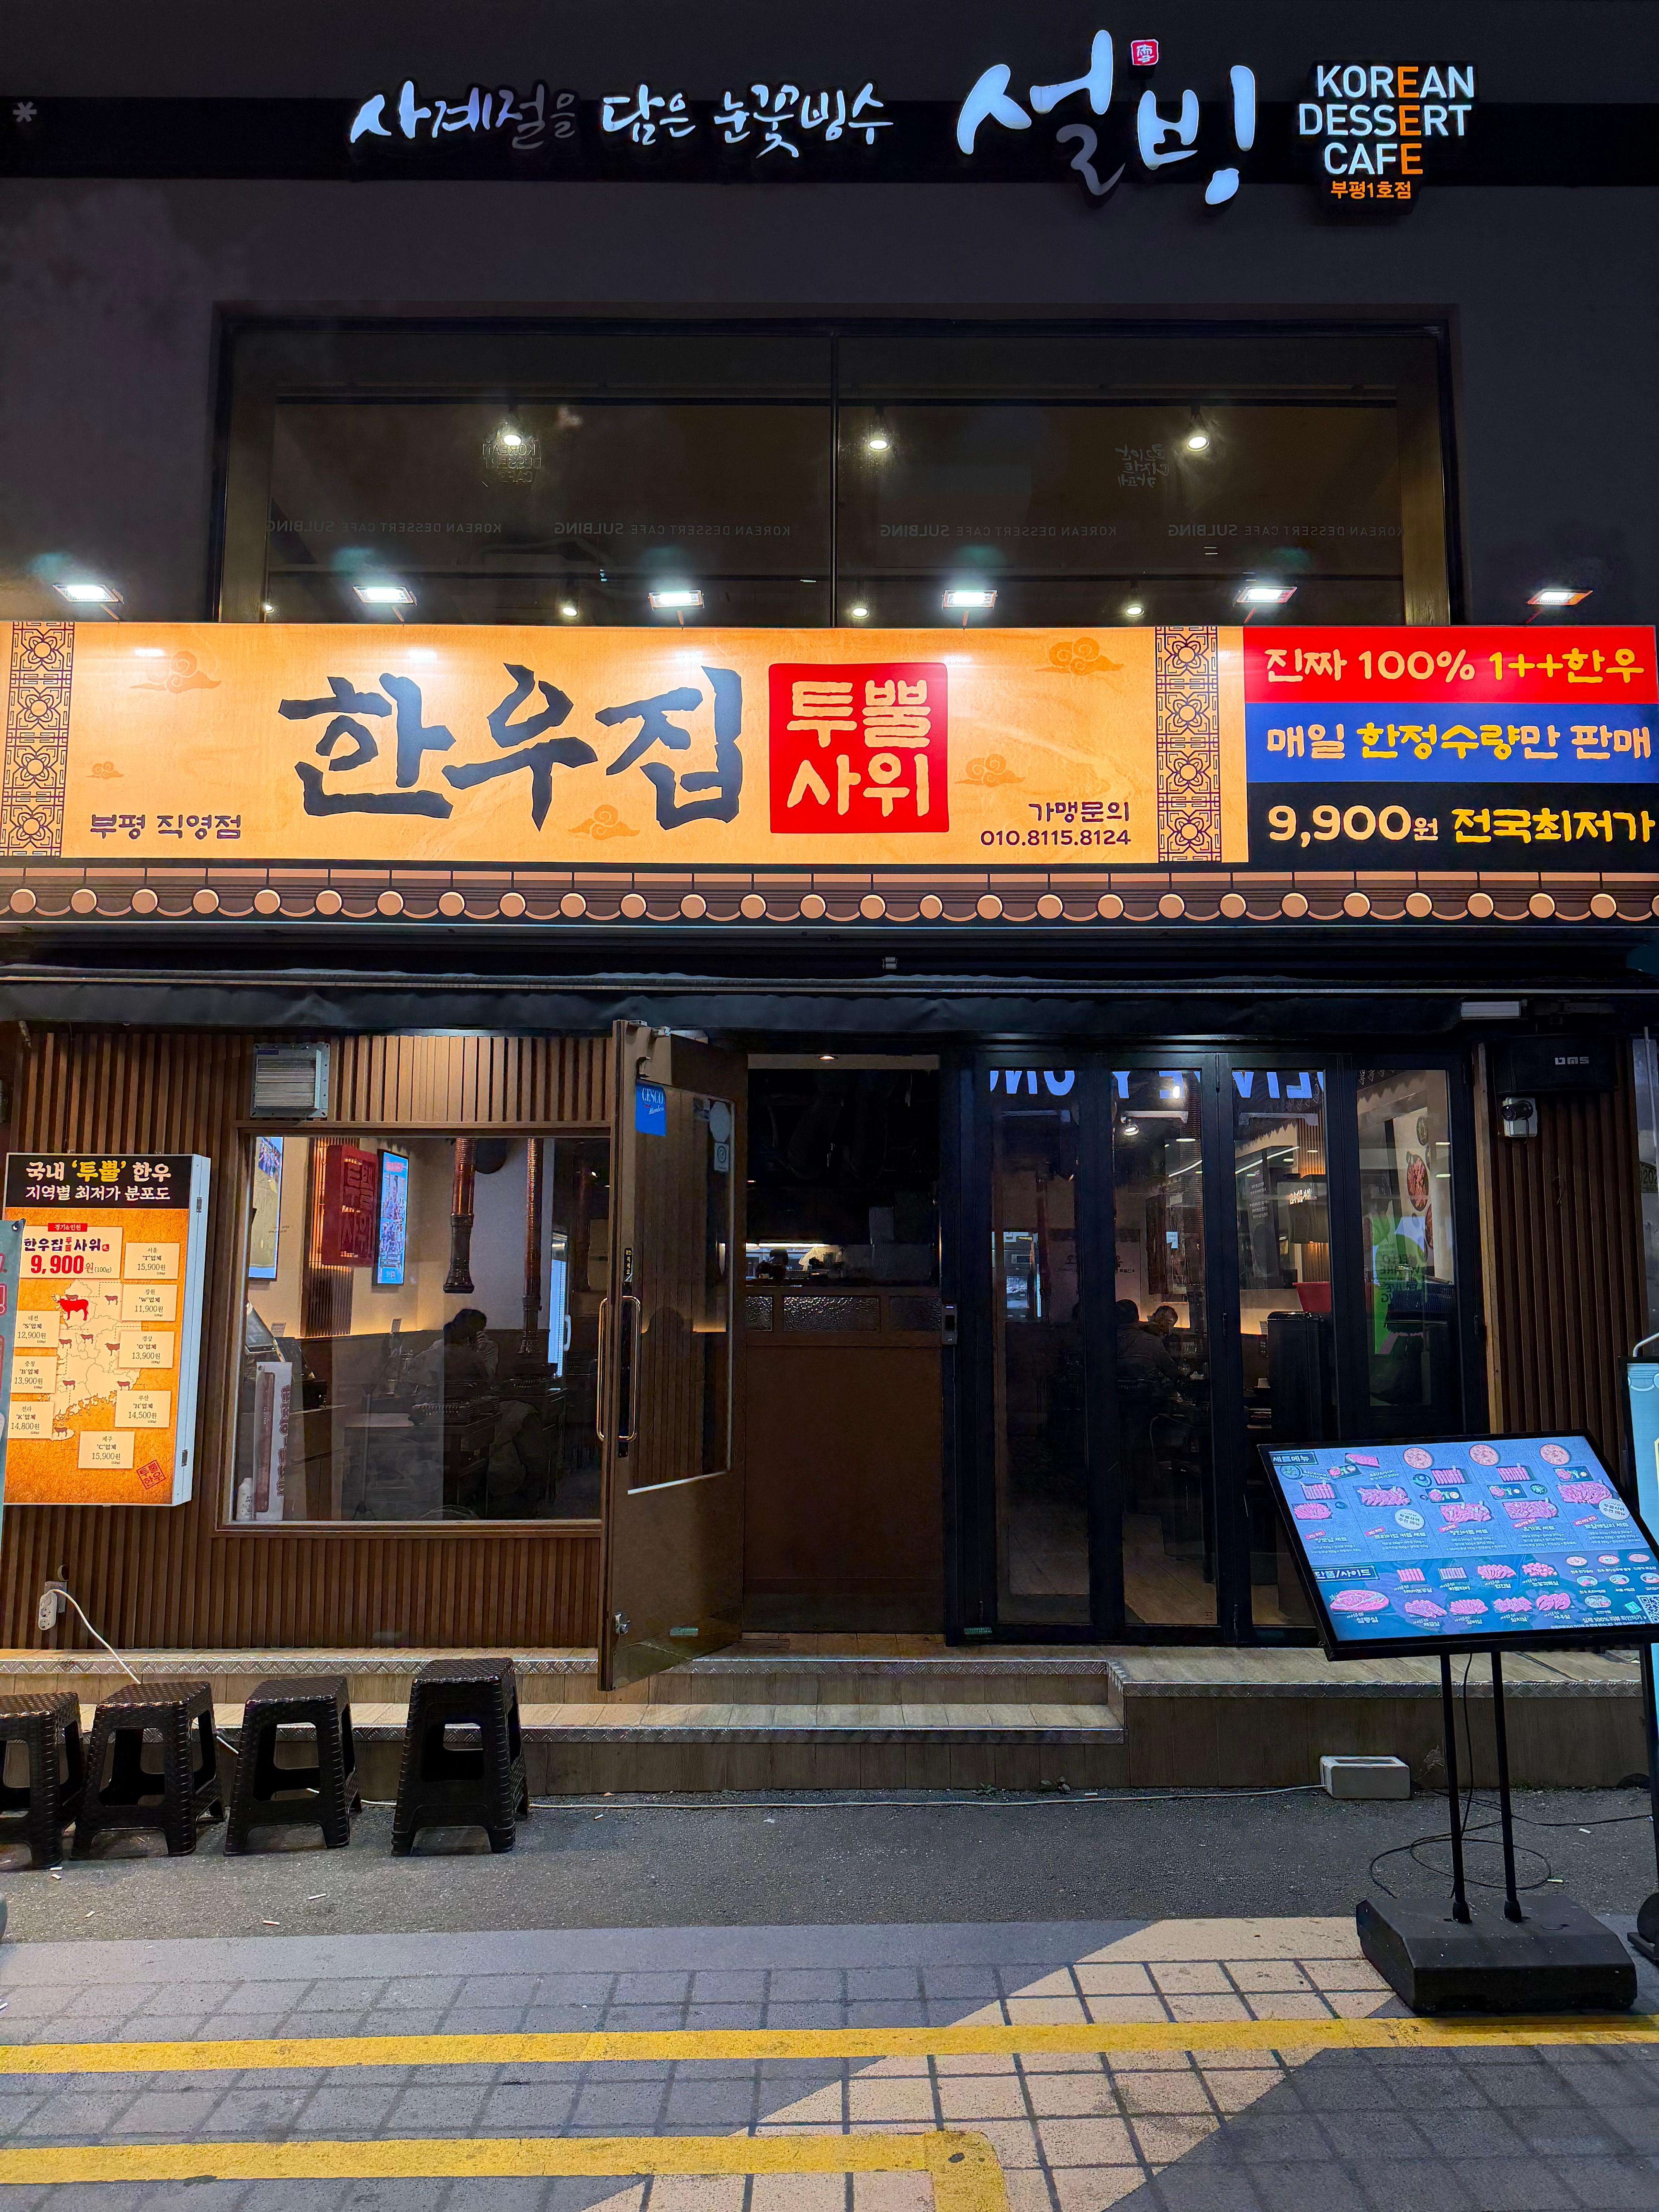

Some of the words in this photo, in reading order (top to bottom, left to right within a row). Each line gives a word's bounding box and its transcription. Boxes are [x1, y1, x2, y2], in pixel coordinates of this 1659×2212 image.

[1317, 65, 1474, 99] KOREAN
[350, 80, 580, 150] 사계절을
[602, 84, 696, 145] 담은
[714, 83, 894, 157] 눈꽃빙수
[957, 29, 1255, 205] 설빙
[1299, 103, 1472, 137] DESSERT
[1323, 142, 1424, 176] CAFE
[1330, 181, 1412, 200] 부평1호점
[1265, 649, 1347, 683] 진짜
[1358, 649, 1475, 683] 100%
[1490, 648, 1644, 684] 1++한우
[787, 678, 931, 749] 투뿔
[278, 662, 742, 831] 한우집
[1267, 724, 1346, 759] 매일
[1357, 722, 1560, 760] 한정수량만
[1570, 725, 1651, 759] 판매
[787, 752, 931, 818] 사위
[1029, 802, 1131, 824] 가맹문의
[90, 814, 146, 840] 부평
[156, 814, 242, 840] 직영점
[1267, 805, 1439, 848] 9,900원
[1451, 808, 1656, 843] 전국최저가
[980, 830, 1132, 848] 010.8115.8124
[642, 1087, 664, 1104] CESCO
[26, 1162, 65, 1182] 국내
[132, 1162, 172, 1182] 한우
[26, 1185, 70, 1200] 지역별
[75, 1186, 121, 1200] 최저가
[125, 1186, 171, 1201] 분포도
[24, 1238, 64, 1252] 한우집
[74, 1238, 101, 1252] 사위
[31, 1255, 94, 1274] 9,900원
[17, 1331, 46, 1340] 12,900원
[132, 1352, 160, 1360] 13,900원
[14, 1377, 43, 1385] 13,900원
[11, 1422, 40, 1431] 14,800원
[92, 1453, 121, 1461] 15,900원
[1314, 1568, 1372, 1580] 단품/사이드
